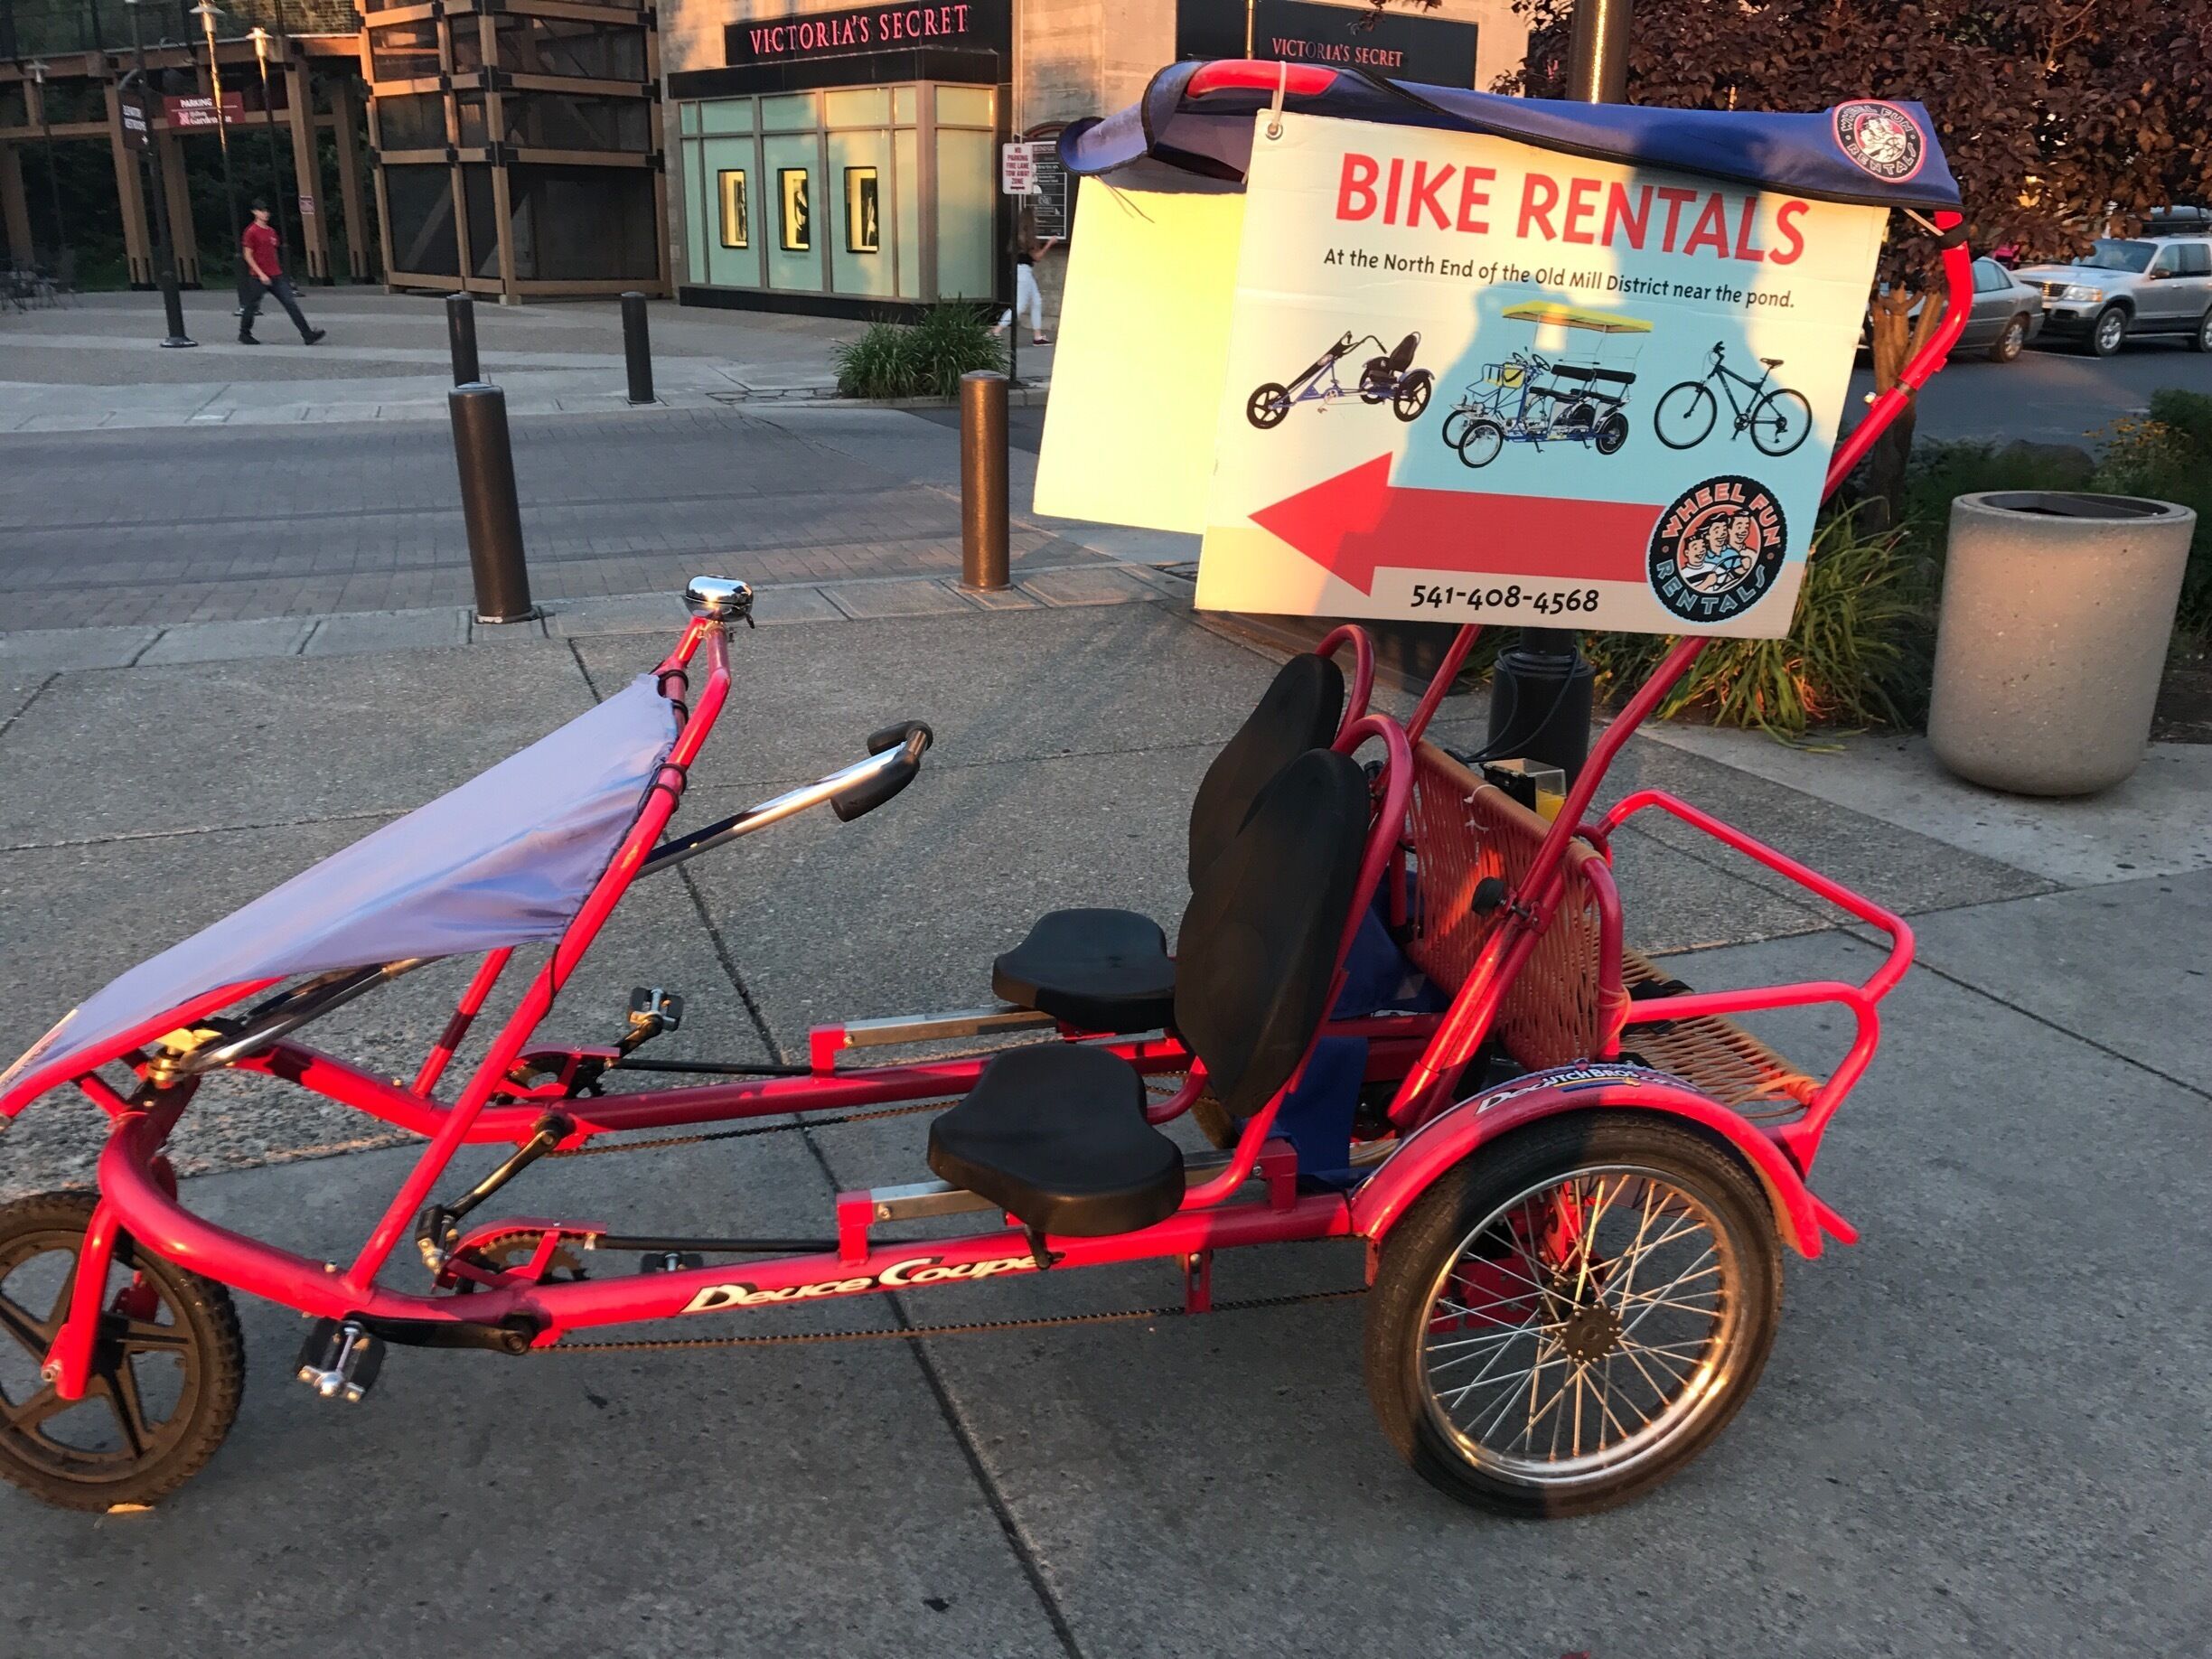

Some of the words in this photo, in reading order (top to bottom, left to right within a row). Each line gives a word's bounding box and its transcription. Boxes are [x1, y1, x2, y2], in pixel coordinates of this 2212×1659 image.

[749, 15, 869, 55] VICTORIA'S
[879, 5, 969, 41] SECRET
[1271, 37, 1351, 62] VICTORIA'S
[1354, 46, 1403, 68] SECRET
[1840, 105, 1878, 132] WHEEL
[1880, 108, 1913, 132] FUN
[1847, 142, 1917, 175] RENTALS
[1336, 152, 1497, 234] BIKE
[1515, 172, 1811, 266] RENTALS
[1323, 248, 1345, 265] At
[1349, 248, 1379, 268] the
[1383, 254, 1435, 274] North
[1440, 259, 1474, 277] End
[1478, 262, 1498, 285] of
[1503, 263, 1536, 283] the
[1535, 267, 1565, 286] Old
[1569, 270, 1602, 290] Mill
[1607, 274, 1670, 296] District
[1673, 284, 1711, 300] near
[1715, 284, 1742, 303] the
[1745, 290, 1795, 309] pond.
[1662, 483, 1746, 539] WHEEL
[1748, 492, 1781, 548] FUN
[1411, 585, 1599, 614] 541-408-4568
[1656, 558, 1766, 615] RENTALS
[679, 1277, 874, 1313] Deuce
